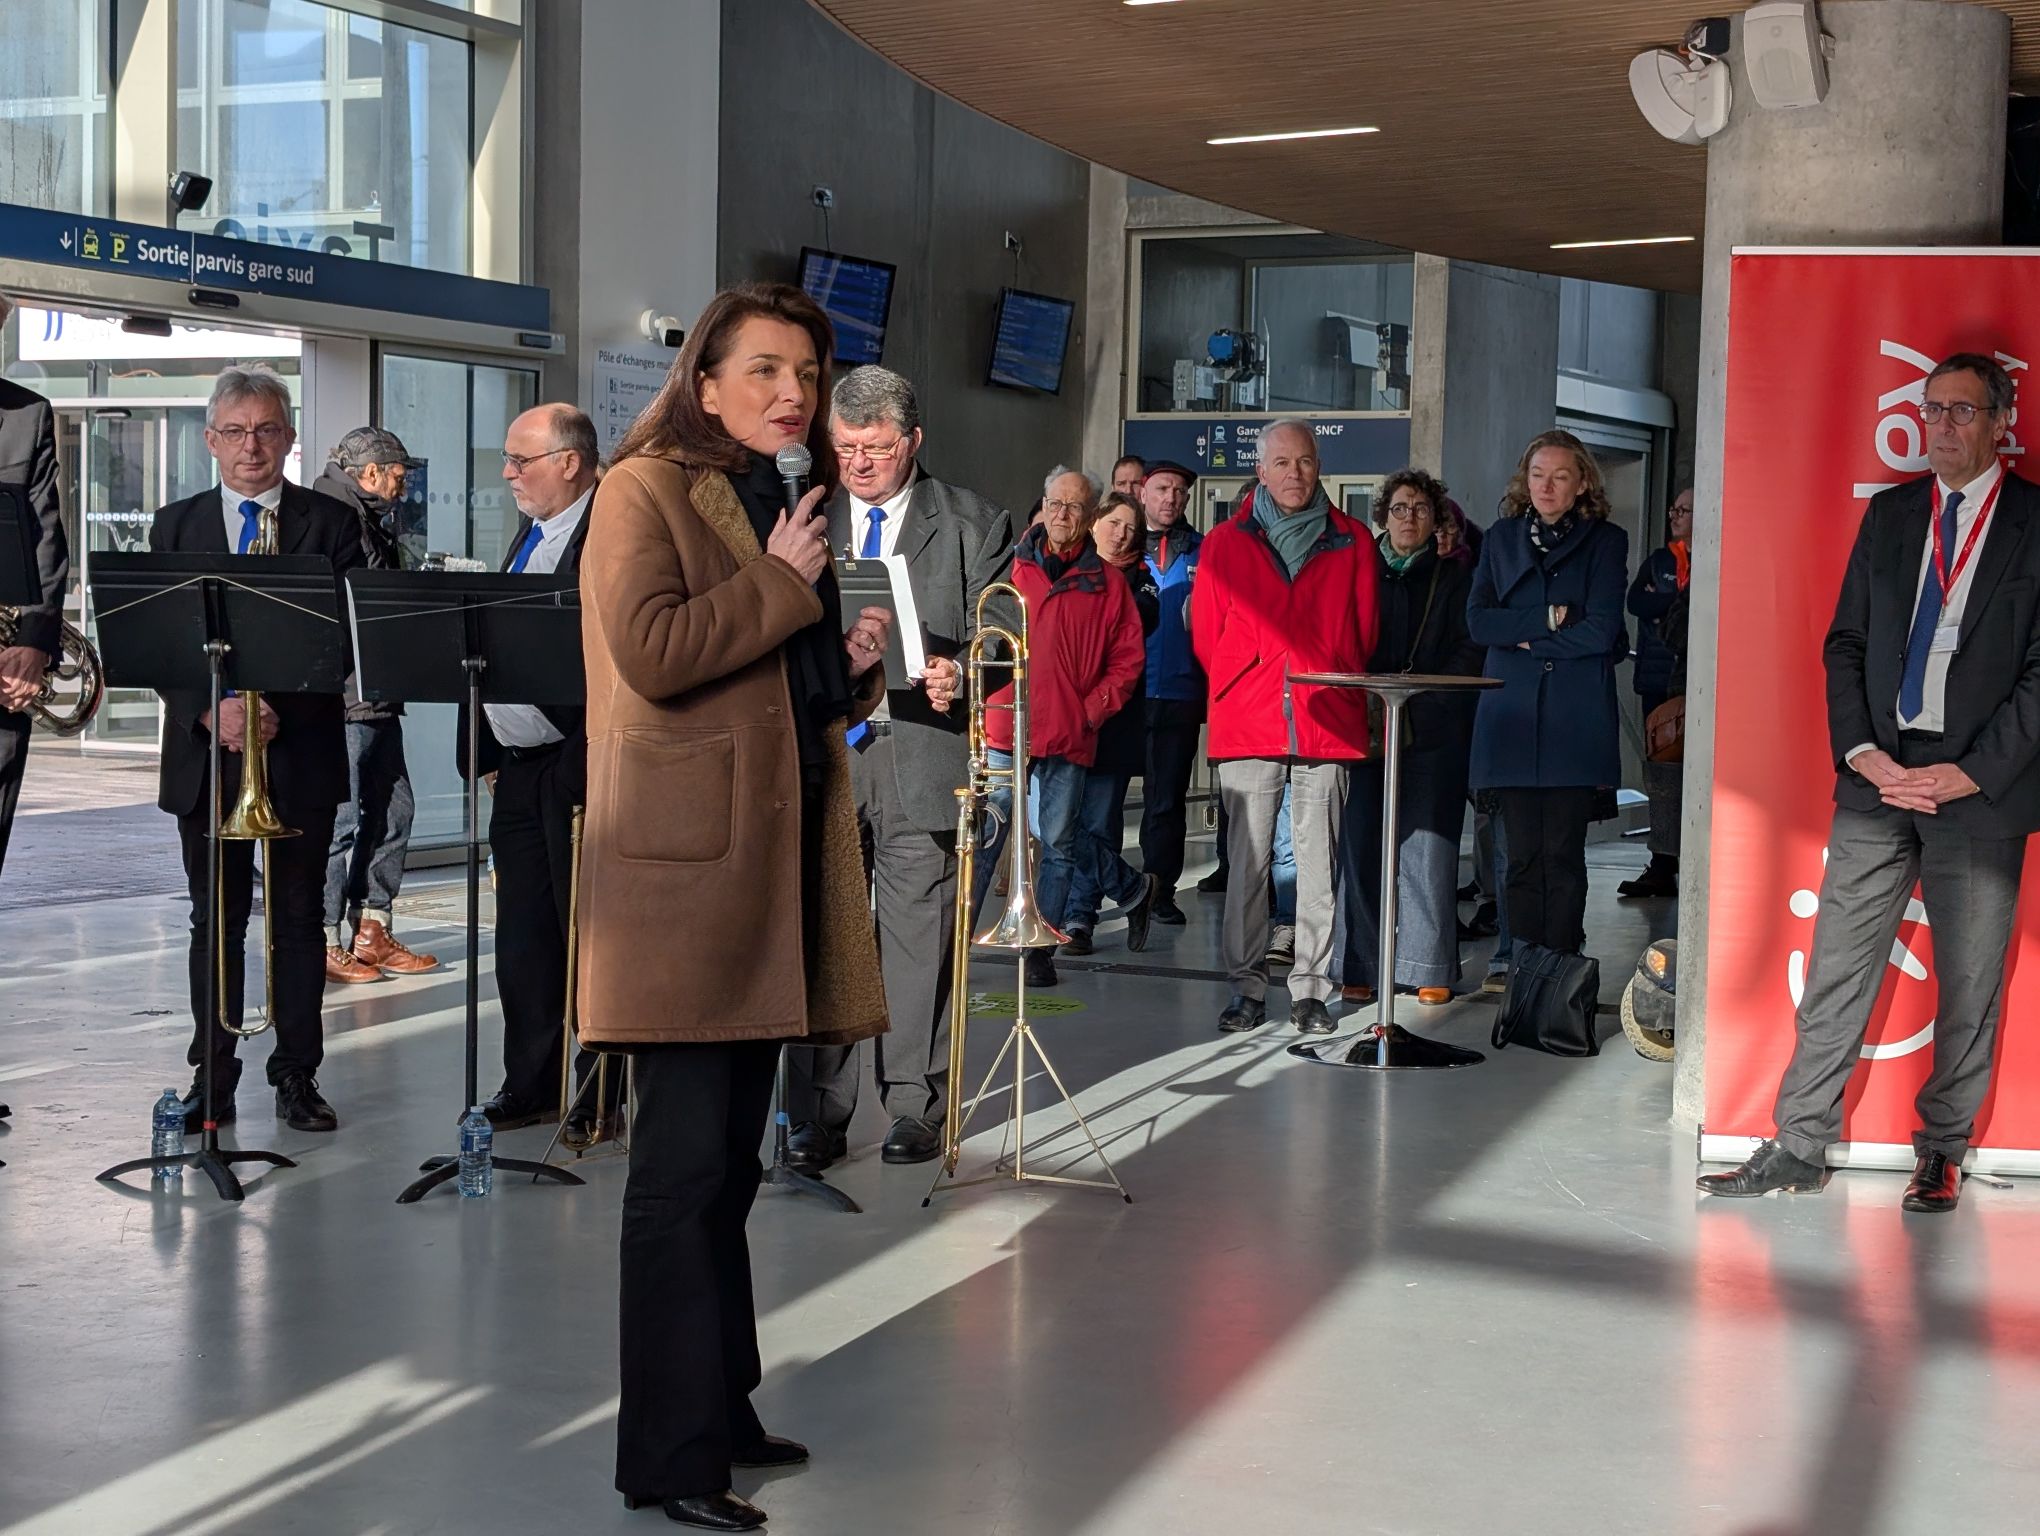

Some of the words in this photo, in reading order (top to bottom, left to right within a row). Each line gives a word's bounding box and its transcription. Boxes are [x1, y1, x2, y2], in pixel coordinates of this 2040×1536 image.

[137, 239, 189, 267] Sortie
[196, 253, 244, 275] parvis
[248, 261, 283, 282] gare
[287, 265, 314, 285] sud
[598, 350, 615, 363] Pôle
[616, 353, 655, 370] d'échanges
[1236, 425, 1260, 436] Gare
[1315, 424, 1344, 436] SNCF
[1236, 449, 1260, 460] Taxis
